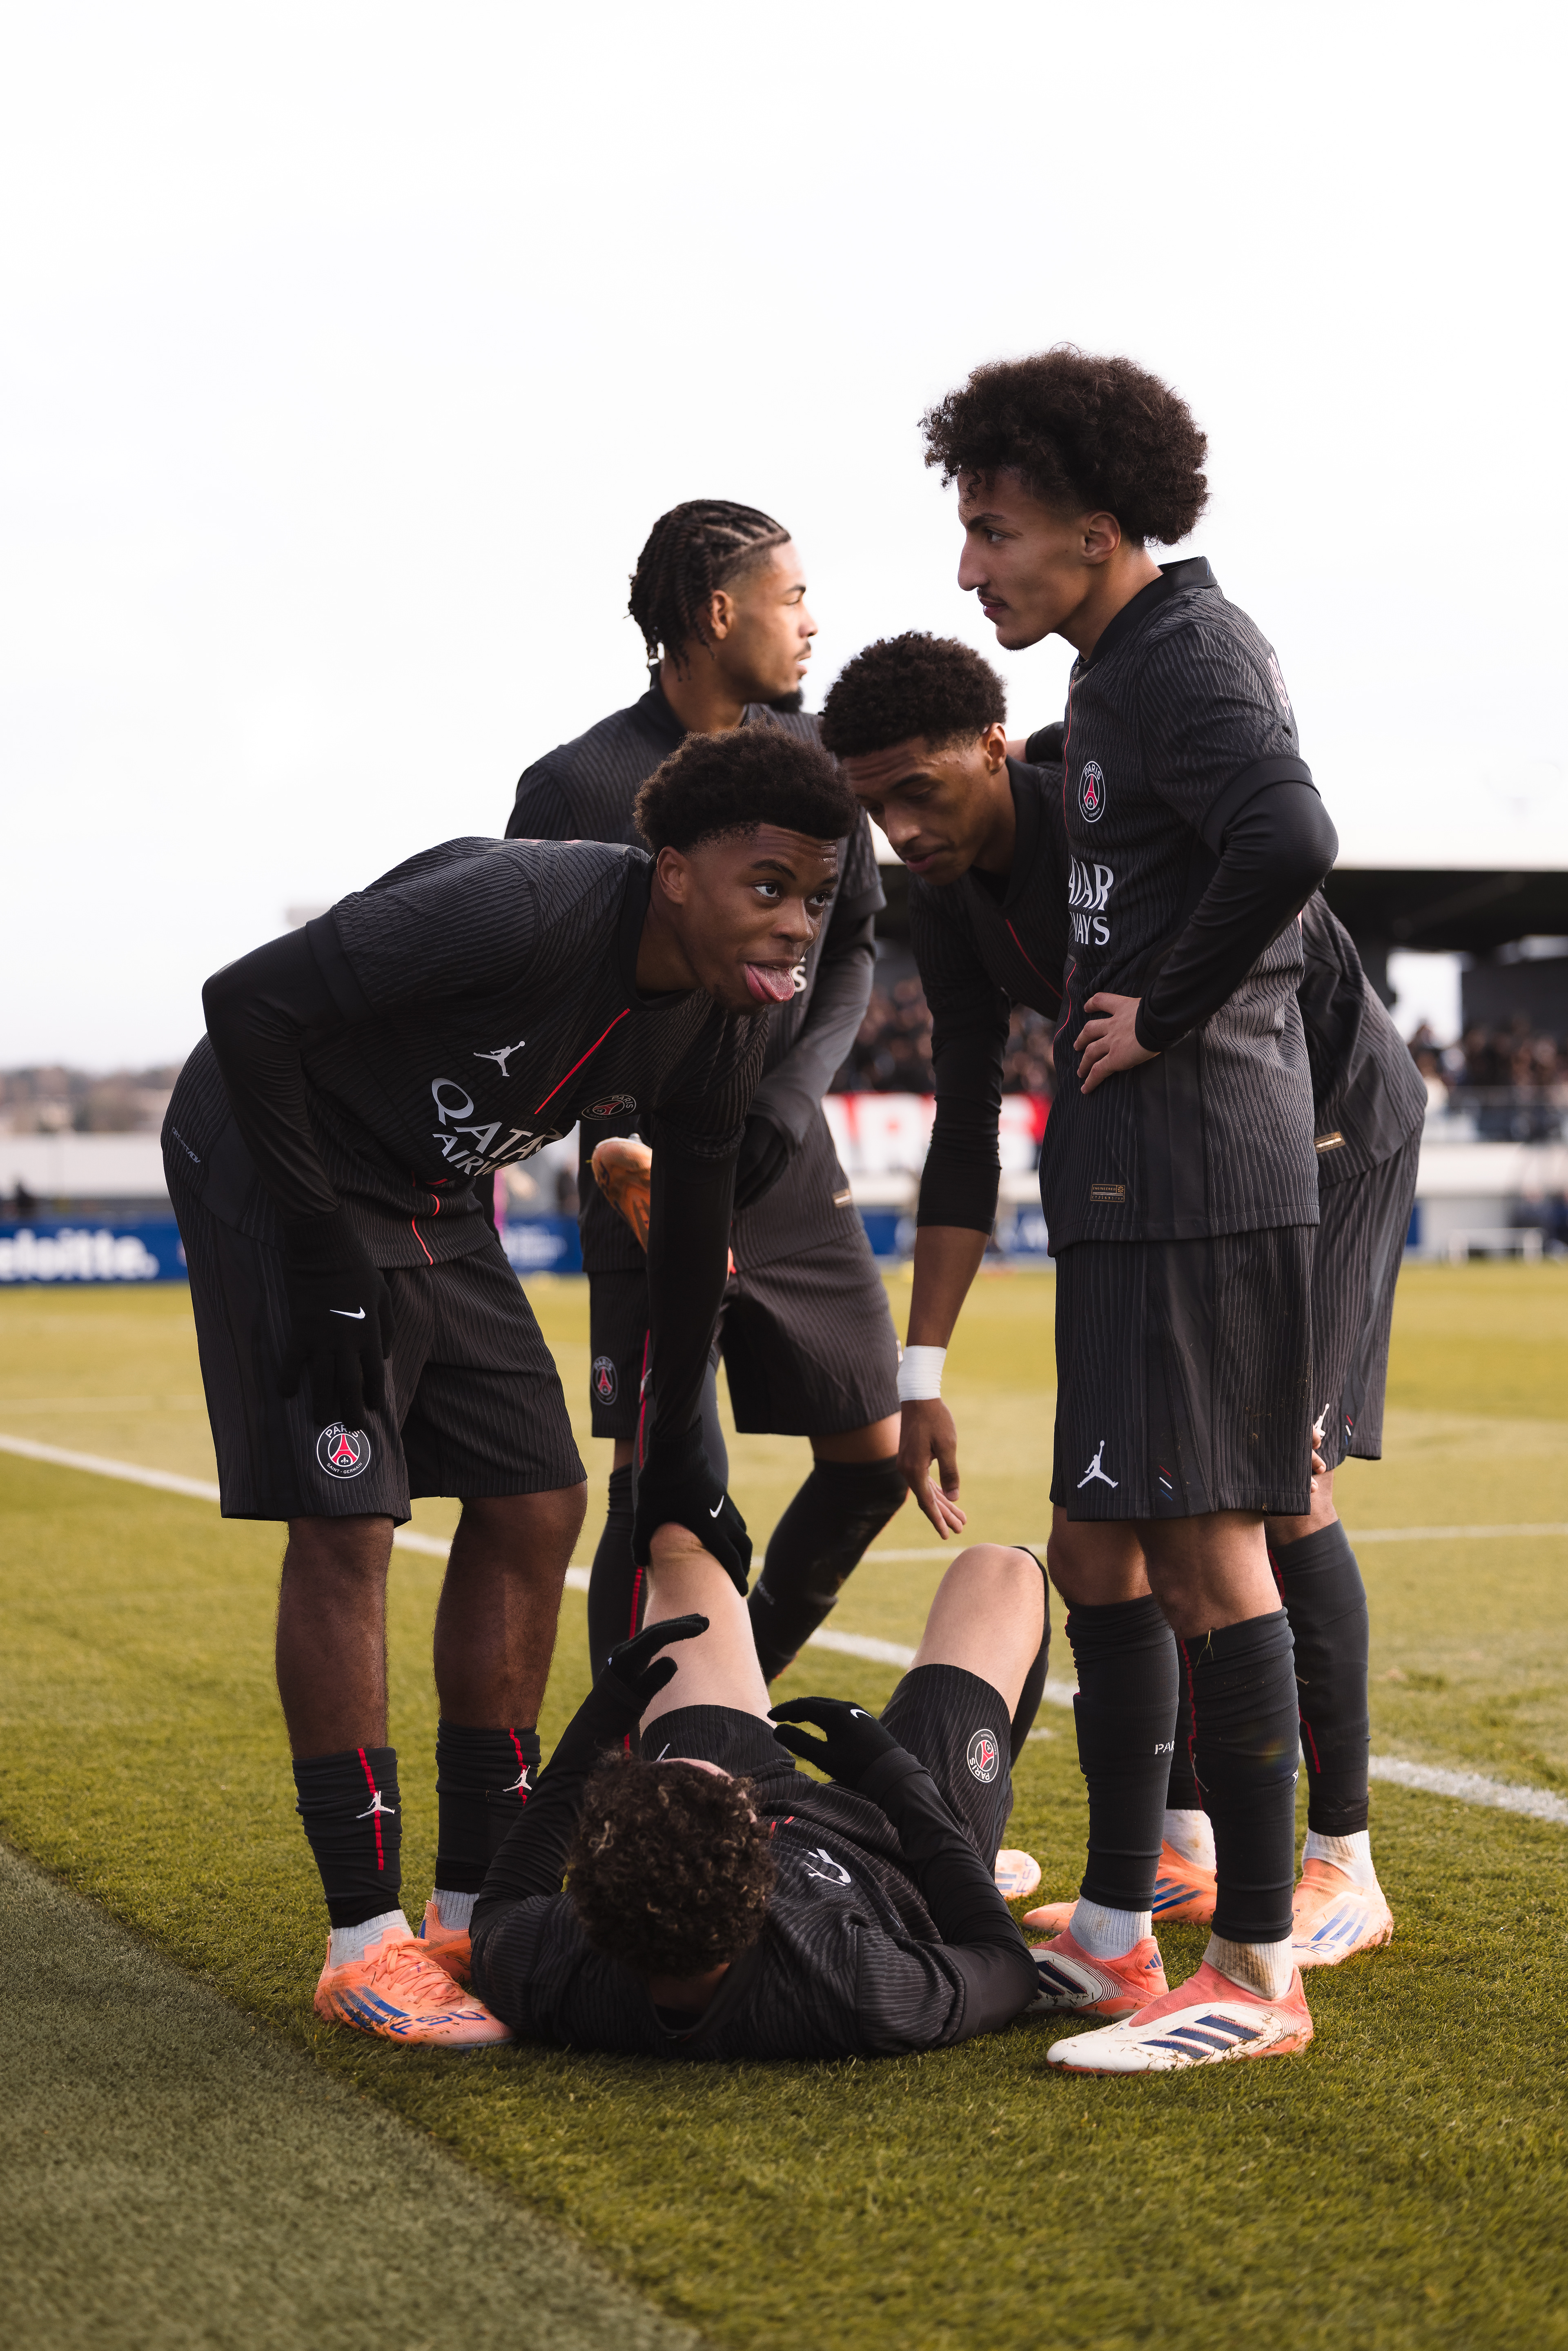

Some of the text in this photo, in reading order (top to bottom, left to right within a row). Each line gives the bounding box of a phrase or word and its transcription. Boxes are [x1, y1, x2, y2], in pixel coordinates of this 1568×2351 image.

[1085, 764, 1101, 780] PARIS
[612, 1096, 633, 1108] PARIS
[969, 1757, 990, 1781] PARIS
